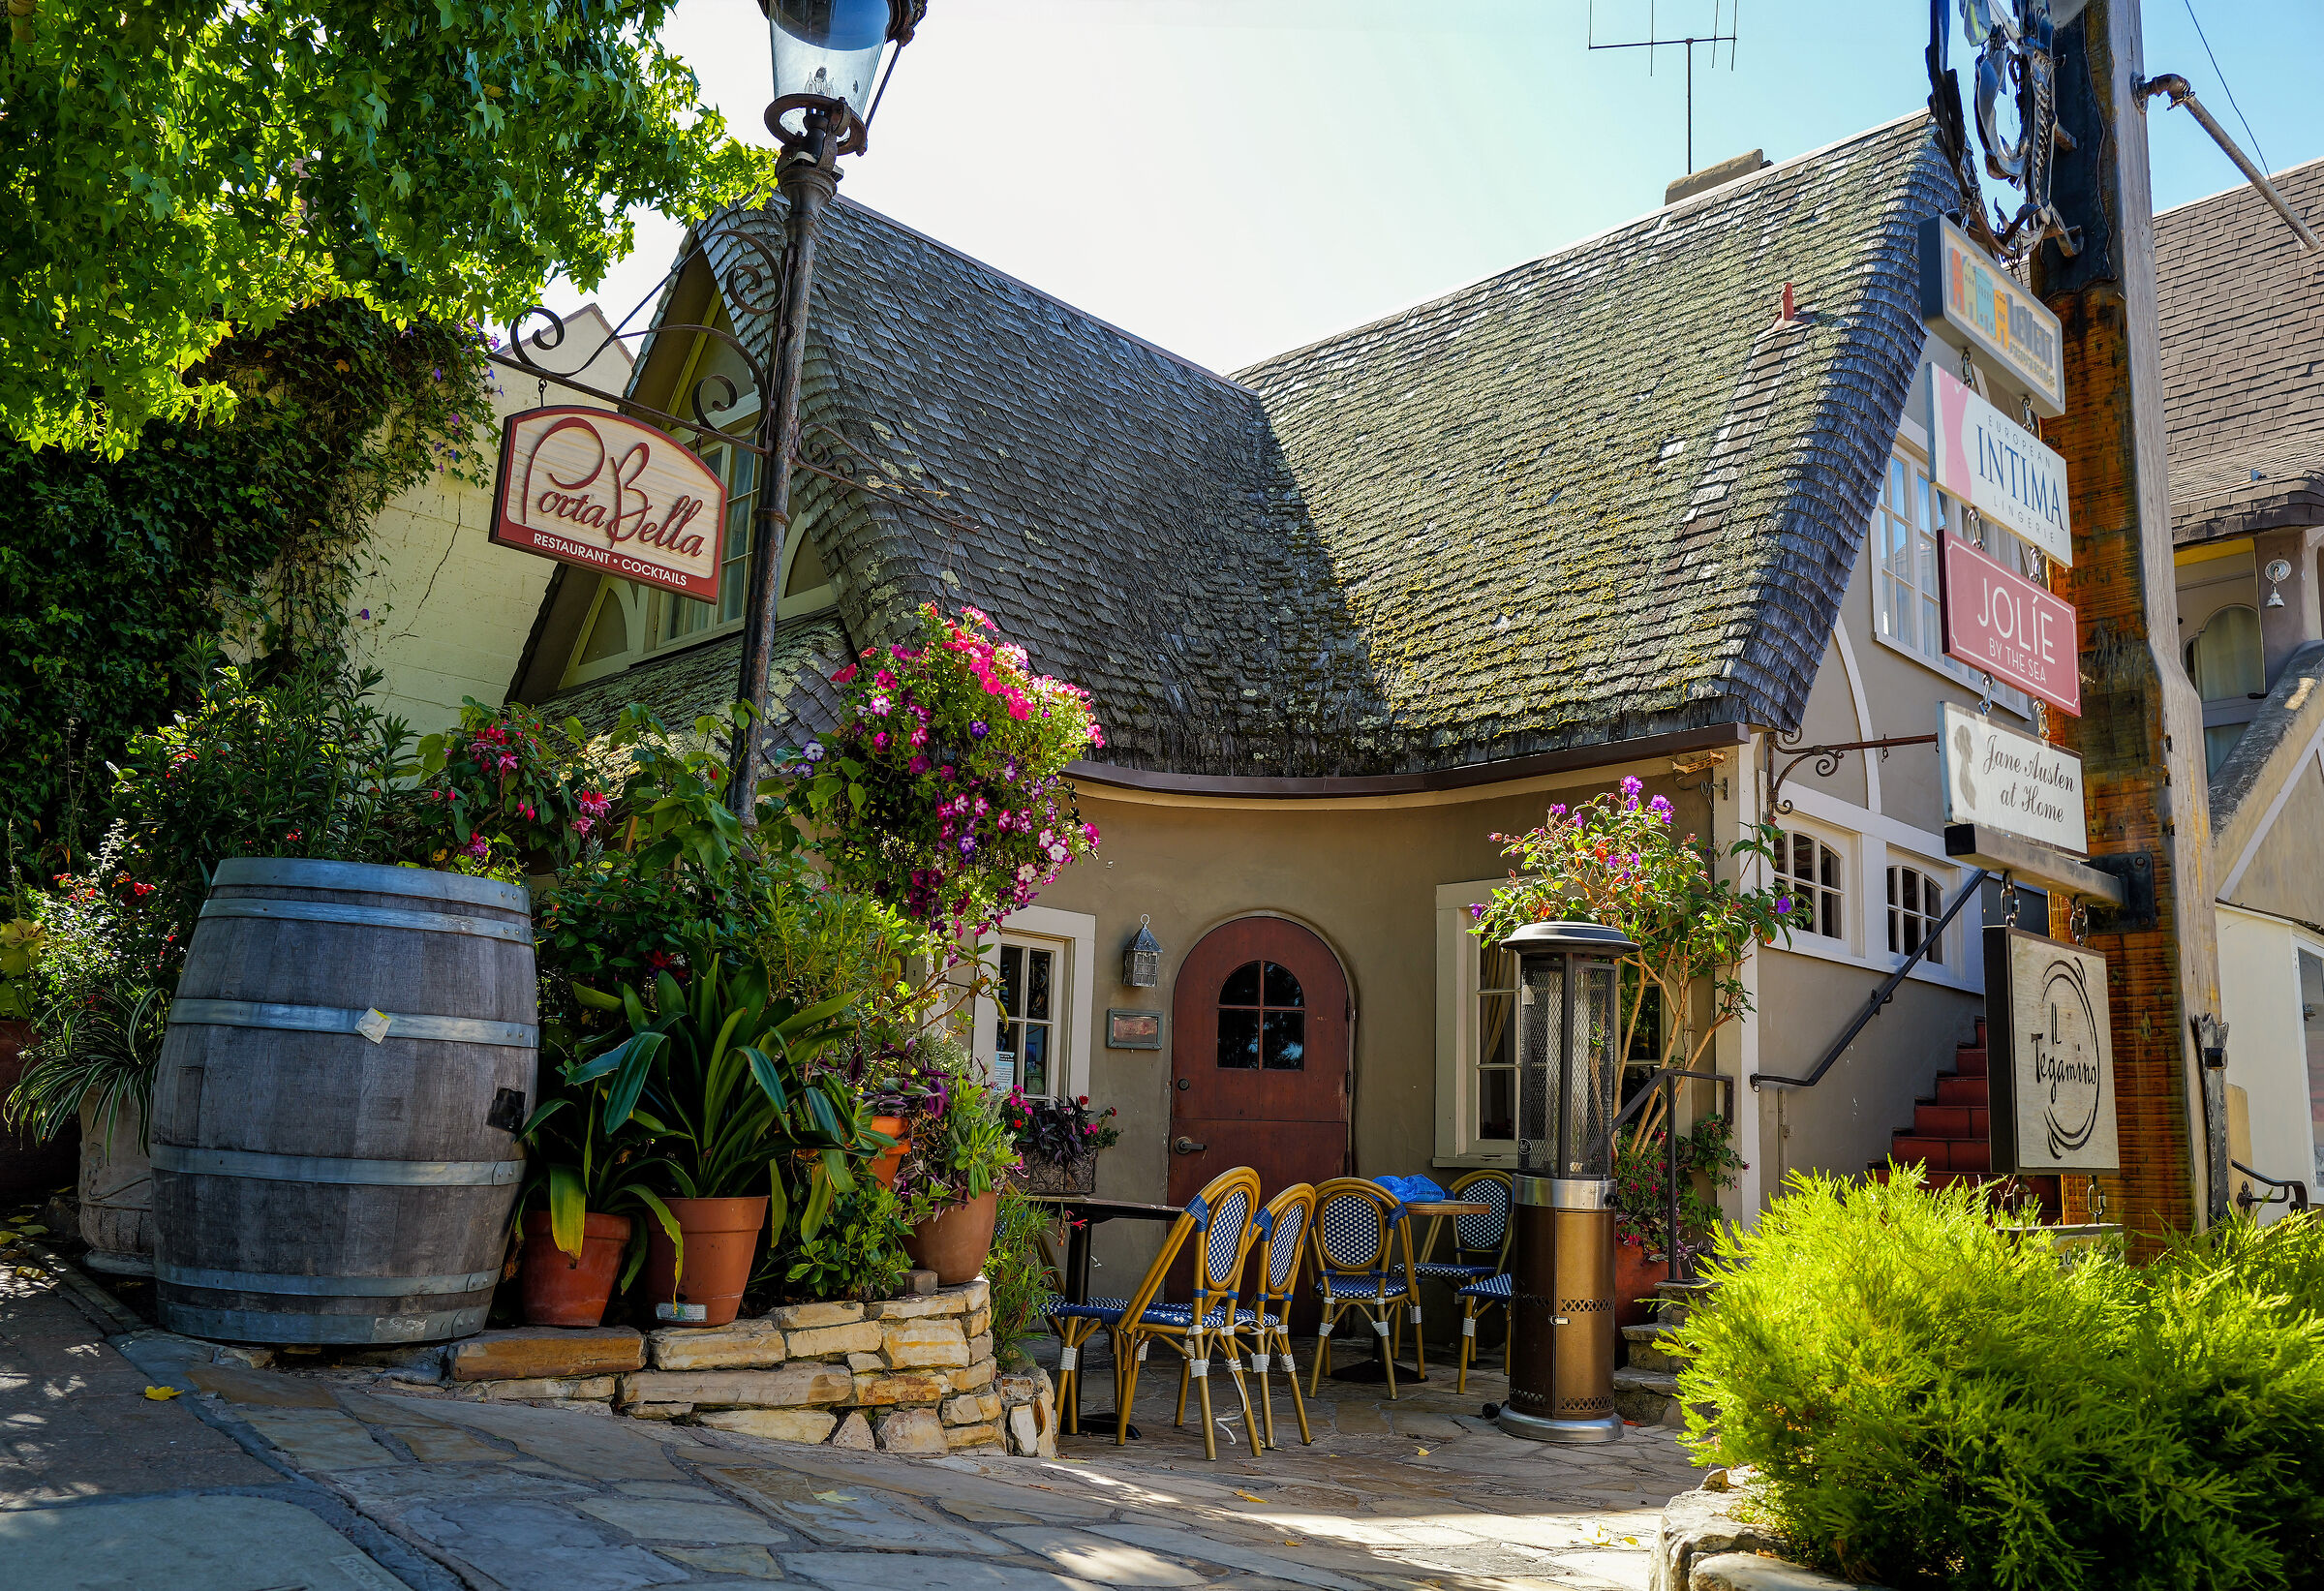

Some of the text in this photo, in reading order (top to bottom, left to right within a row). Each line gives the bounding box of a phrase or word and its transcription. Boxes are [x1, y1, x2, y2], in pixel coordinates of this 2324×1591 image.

[1988, 414, 2051, 470] EUROPEAN
[523, 416, 706, 559] Porta Bella
[1976, 424, 2065, 532] INTIMA
[1993, 495, 2054, 543] LINGERIE
[534, 533, 688, 586] RESTAURANT COCKTAILS
[1989, 637, 2047, 684] BY THE SEA
[1983, 734, 2075, 793] Jane Austen
[2001, 781, 2064, 823] at Home
[2031, 1032, 2096, 1104] Tegamino
